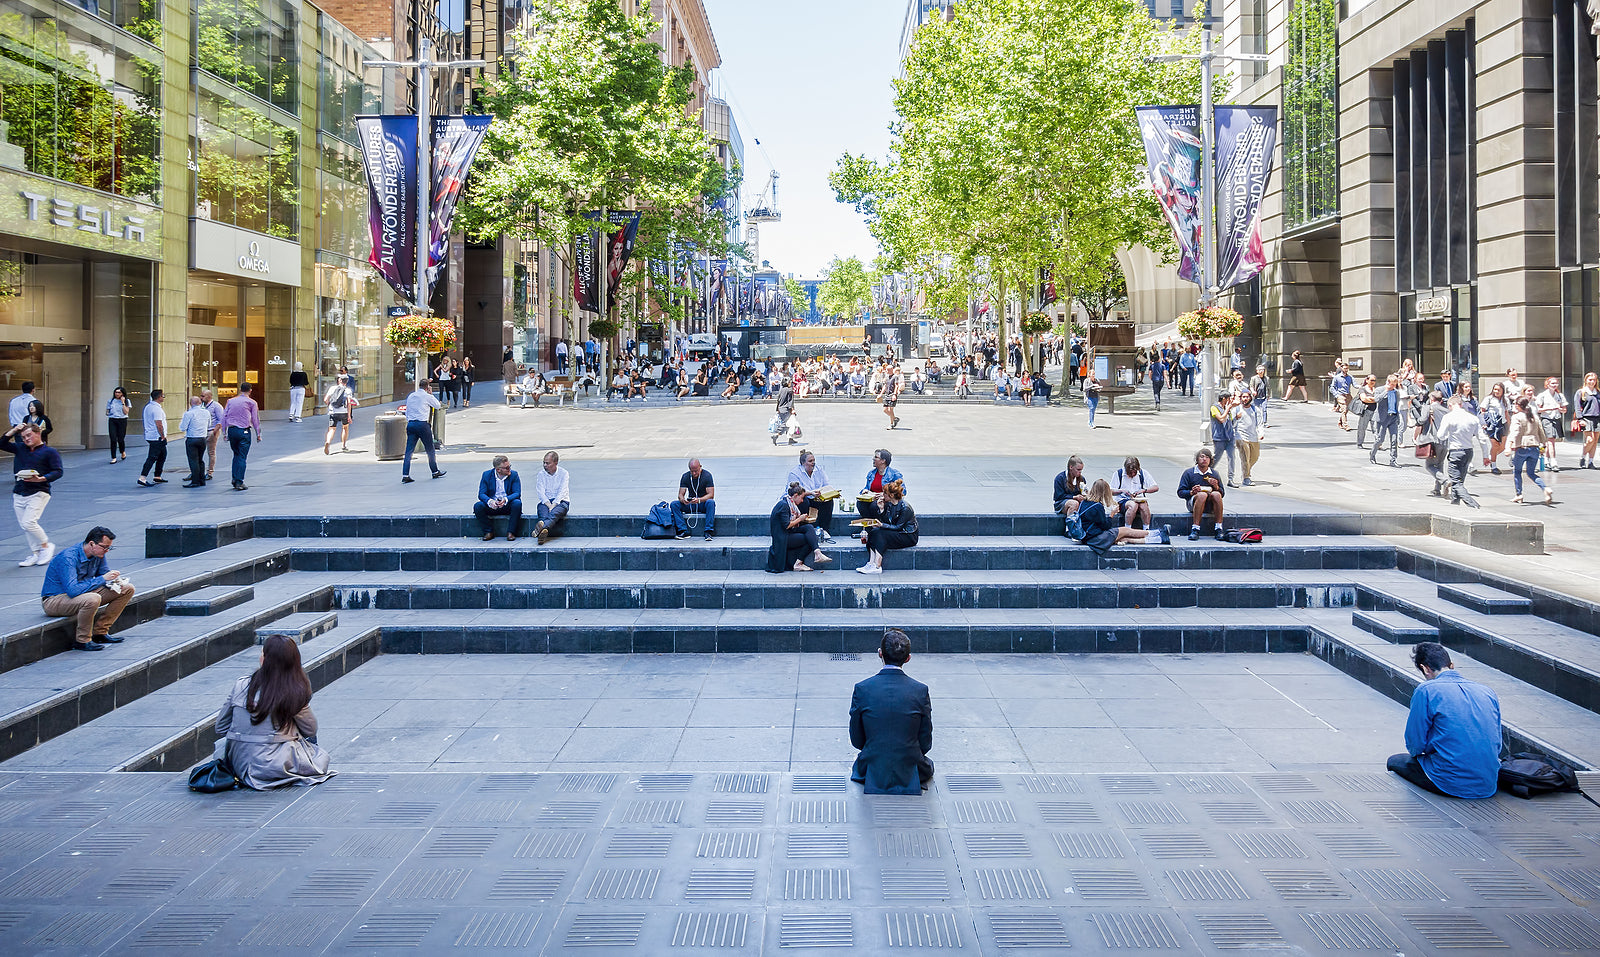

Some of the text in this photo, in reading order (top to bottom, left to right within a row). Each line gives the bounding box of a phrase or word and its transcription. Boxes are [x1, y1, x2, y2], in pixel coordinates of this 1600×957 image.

[19, 191, 145, 243] TESLA
[385, 141, 398, 242] WONDERLAND
[239, 256, 270, 273] OMEGA
